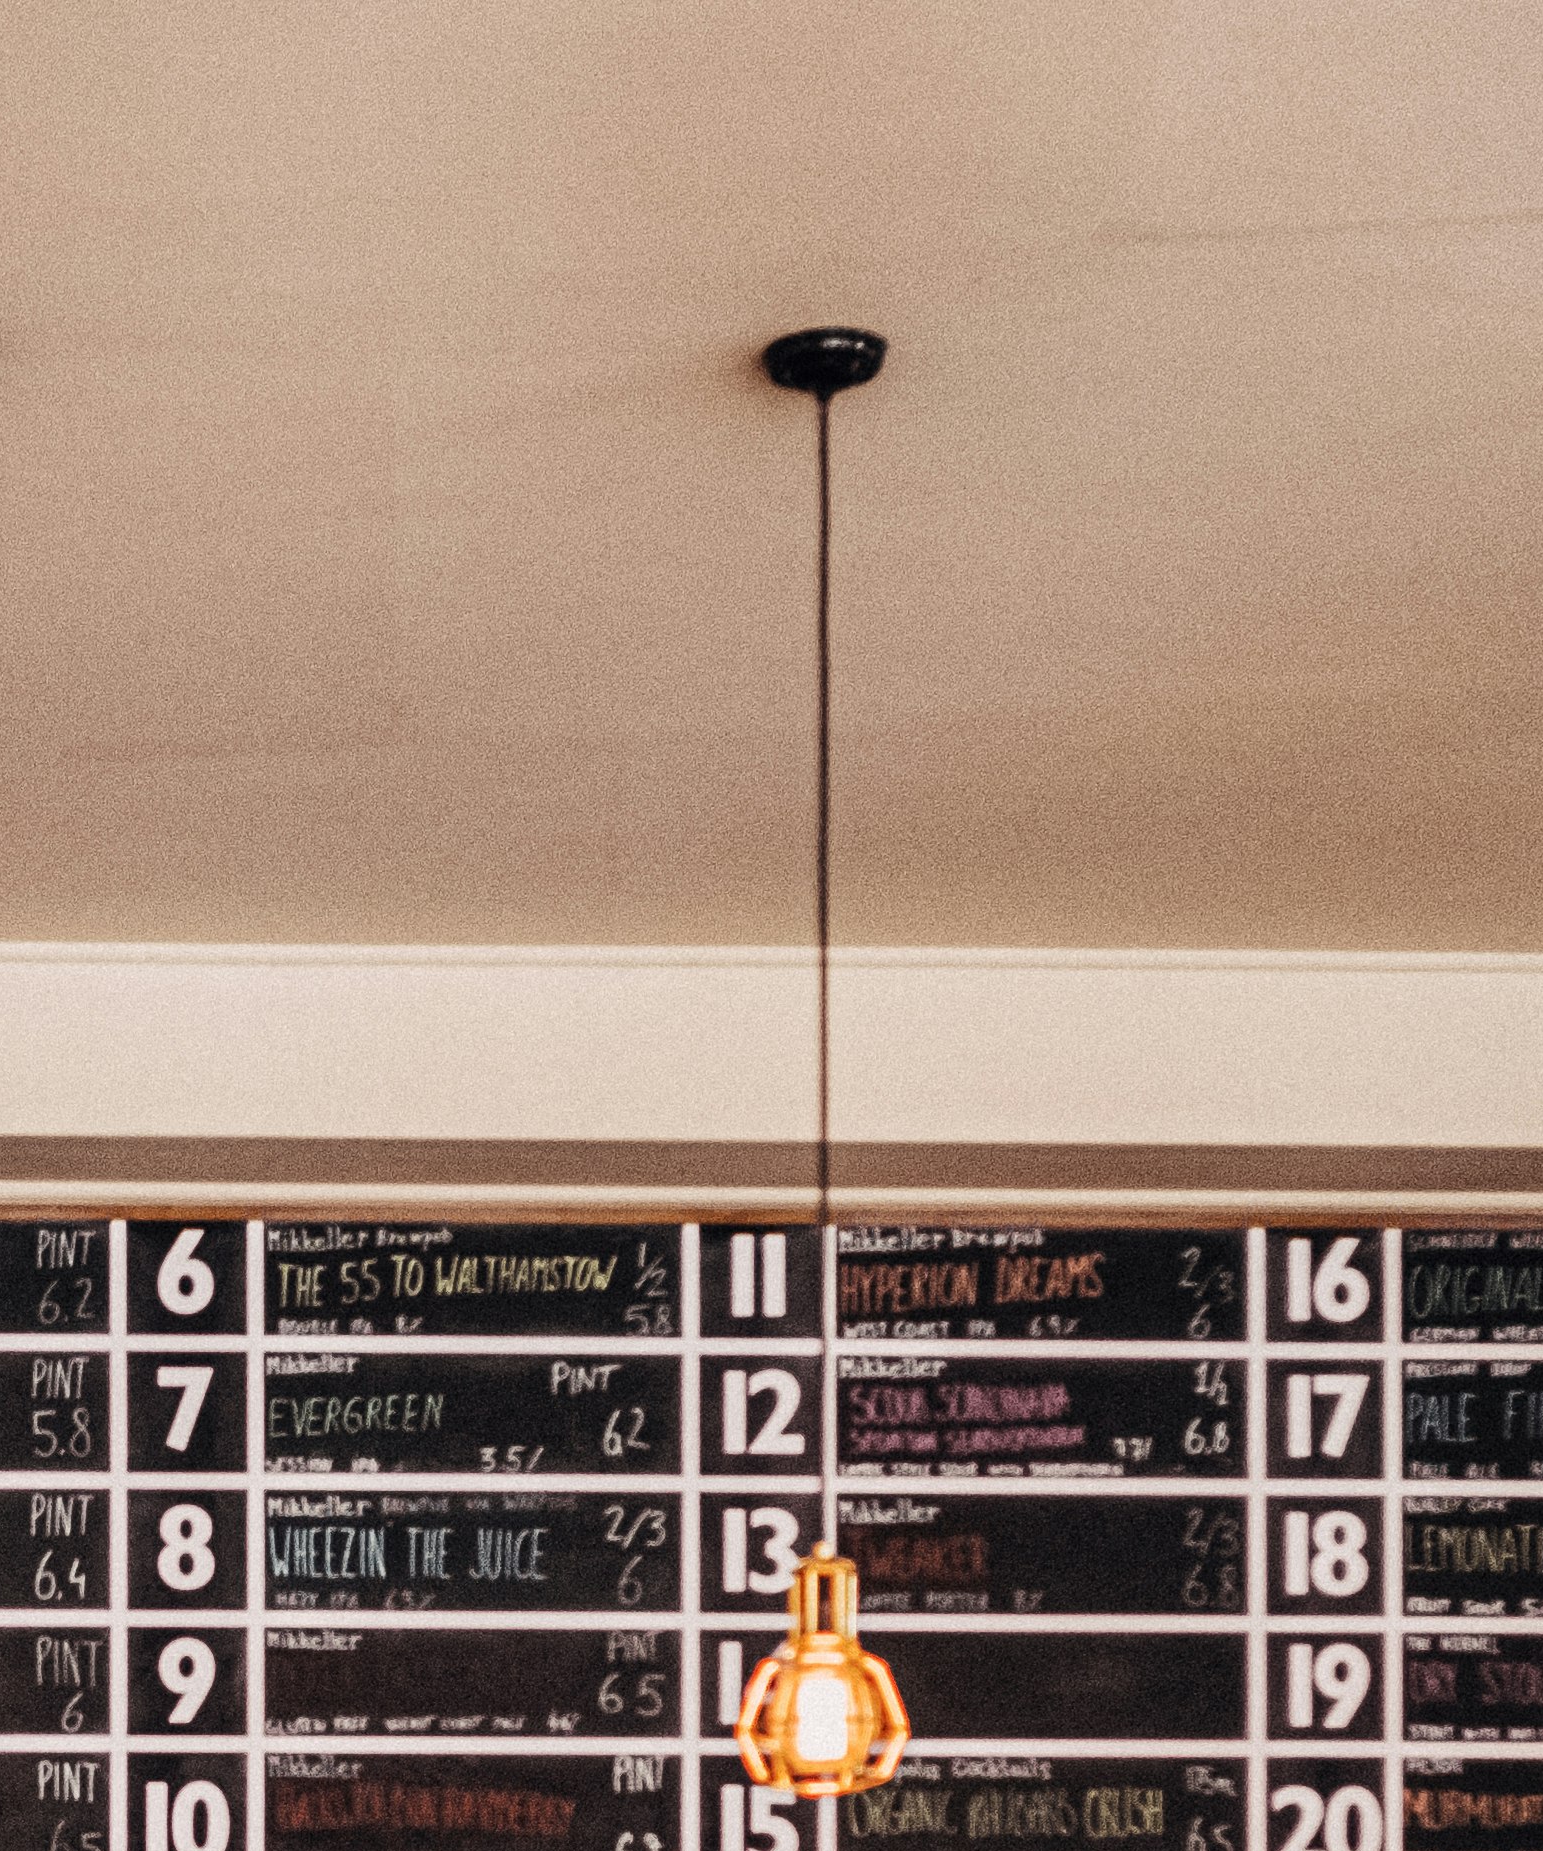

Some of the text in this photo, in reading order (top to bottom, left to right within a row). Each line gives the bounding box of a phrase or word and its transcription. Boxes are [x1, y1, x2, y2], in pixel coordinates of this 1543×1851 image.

[36, 1230, 95, 1268] PINT
[267, 1227, 368, 1252] Mikkeller
[839, 1230, 943, 1252] Mikkeller
[157, 1228, 214, 1315] 6
[278, 1262, 325, 1308] THE
[392, 1255, 422, 1298] TO
[435, 1255, 617, 1297] WALTHAMSTOW
[731, 1233, 786, 1317] 11
[839, 1252, 1105, 1314] HYPERION DREAMS
[1178, 1246, 1234, 1300] 2/3
[1287, 1236, 1370, 1322] 16
[40, 1277, 93, 1325] 6.2
[31, 1356, 89, 1398] PINT
[266, 1357, 359, 1376] Mikkeller
[550, 1360, 622, 1395] PINT
[32, 1407, 90, 1457] 5.8
[156, 1366, 213, 1452] 7
[269, 1393, 444, 1439] EVERGREEN
[723, 1369, 806, 1455] 12
[1287, 1373, 1370, 1458] 17
[1406, 1392, 1476, 1443] PALE
[30, 1494, 93, 1537] PINT
[267, 1496, 366, 1517] Mikkeller
[605, 1504, 666, 1549] 2/3
[157, 1504, 215, 1591] 8
[407, 1527, 453, 1579] THE
[469, 1528, 548, 1580] JUICE
[723, 1507, 804, 1593] 13
[1284, 1510, 1368, 1596] 18
[34, 1549, 87, 1600] 6.4
[617, 1556, 643, 1603] 6
[36, 1636, 102, 1687] PINT
[606, 1631, 660, 1662] PINT
[158, 1637, 216, 1724] 9
[1287, 1642, 1371, 1728] 19
[61, 1693, 84, 1734] 6
[38, 1760, 98, 1803] PINT
[612, 1756, 666, 1793] PINT
